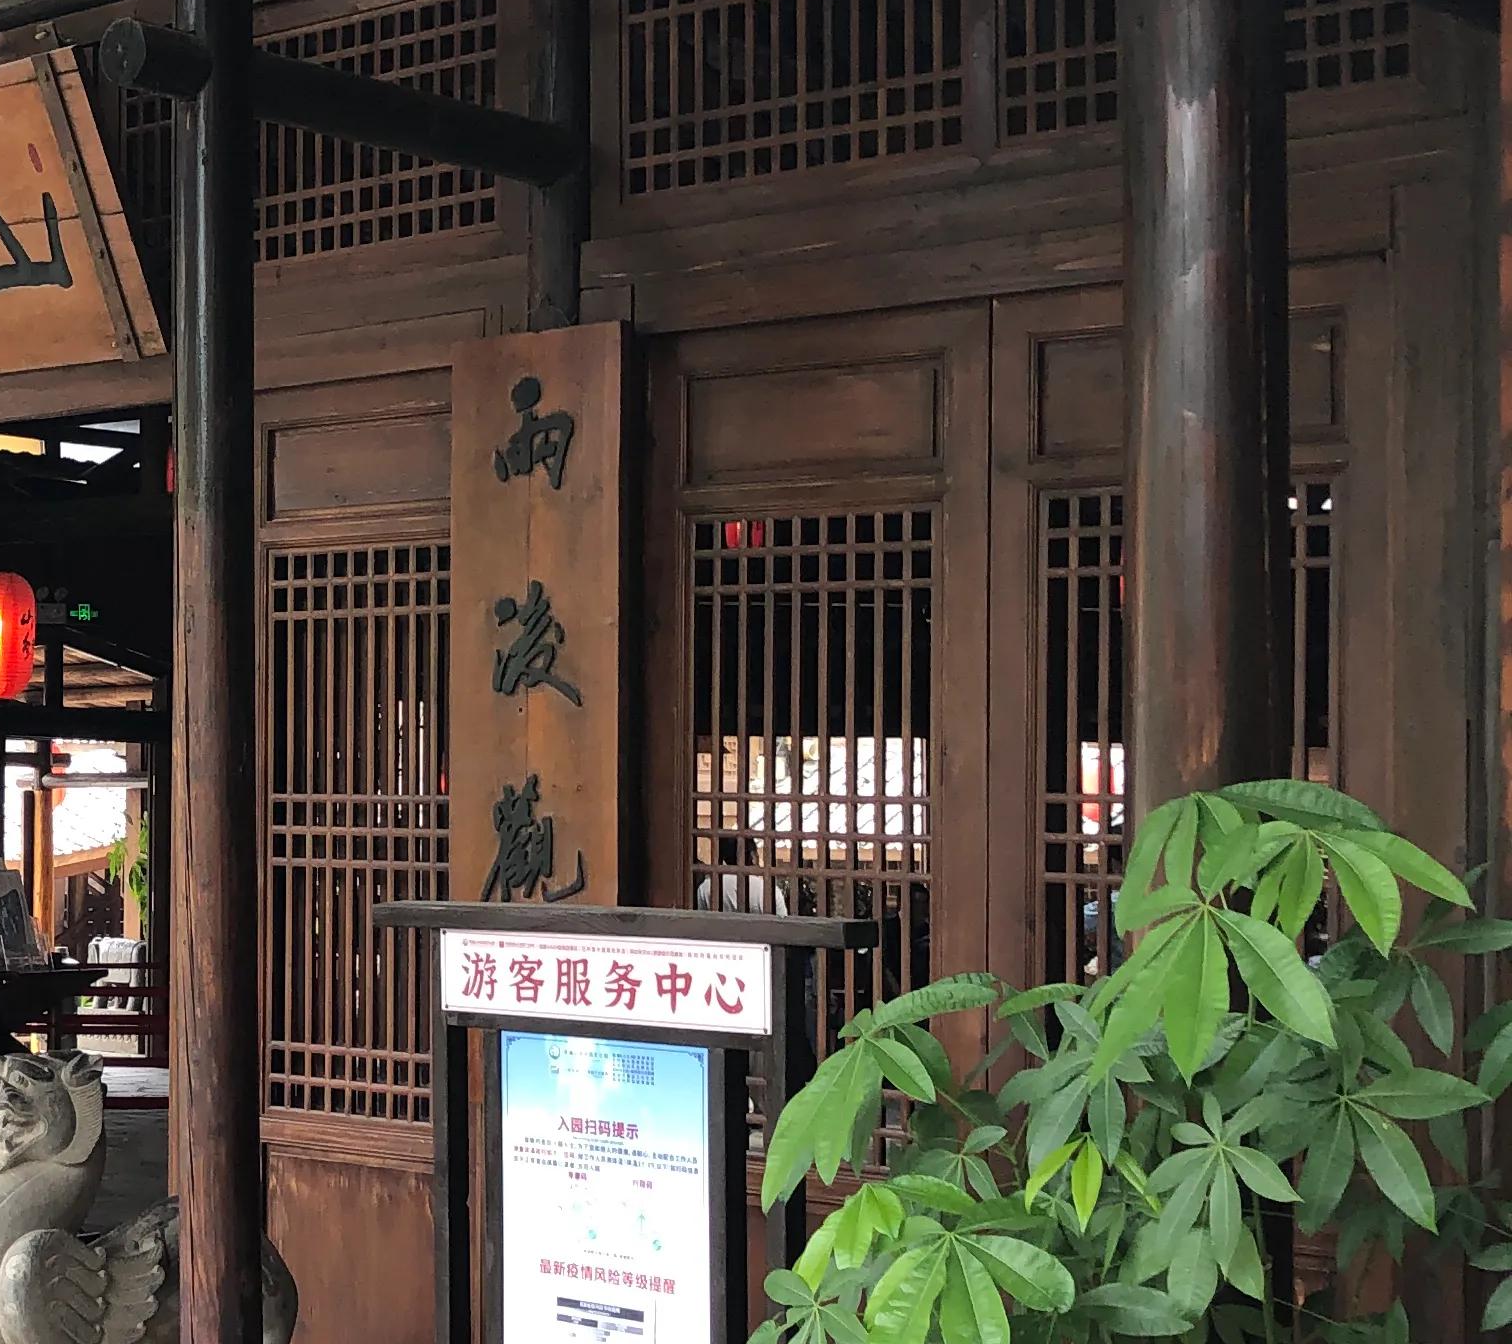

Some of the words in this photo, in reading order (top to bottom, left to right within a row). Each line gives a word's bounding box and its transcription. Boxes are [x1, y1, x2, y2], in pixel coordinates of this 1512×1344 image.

[461, 951, 746, 1015] 游客服务中心
[558, 1115, 639, 1141] 入园扫码提示
[540, 1258, 676, 1295] 最新疫情风险等级提醒
